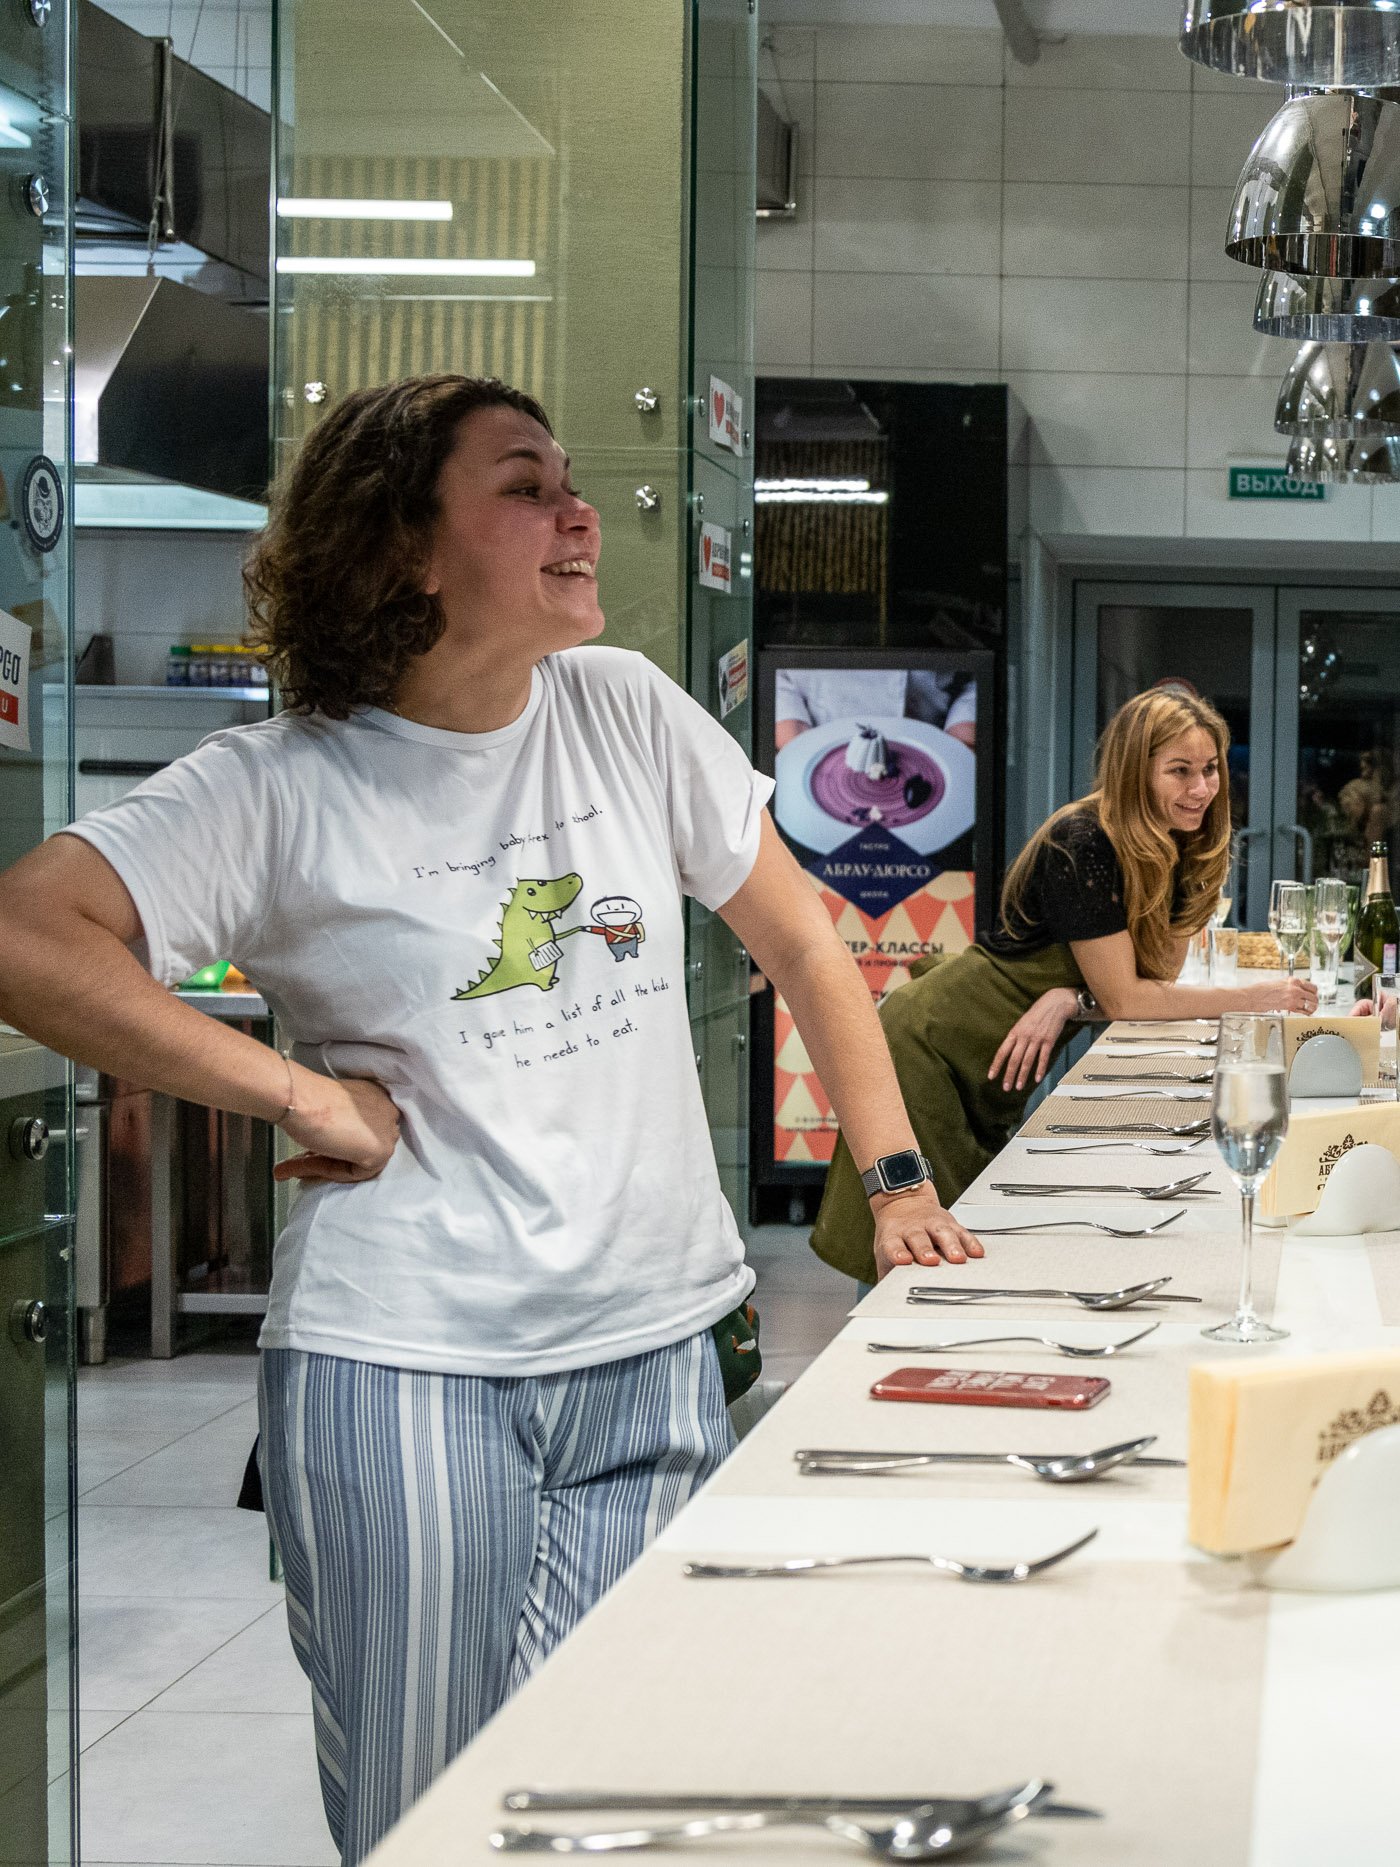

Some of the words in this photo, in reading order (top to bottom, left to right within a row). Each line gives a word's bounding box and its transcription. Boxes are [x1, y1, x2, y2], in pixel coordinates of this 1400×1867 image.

[1236, 473, 1319, 496] ВЫХОД
[413, 866, 439, 879] I'm
[446, 856, 496, 876] bringing
[499, 833, 525, 852] baby
[555, 820, 565, 831] to
[459, 1030, 469, 1044] I
[513, 1020, 534, 1035] him
[560, 1003, 583, 1022] list
[591, 994, 603, 1013] of
[610, 988, 626, 1006] all
[634, 984, 649, 997] the
[652, 977, 670, 993] kids
[514, 1053, 532, 1069] he
[543, 1040, 579, 1062] needs
[586, 1033, 600, 1048] to
[612, 1017, 638, 1039] eat.
